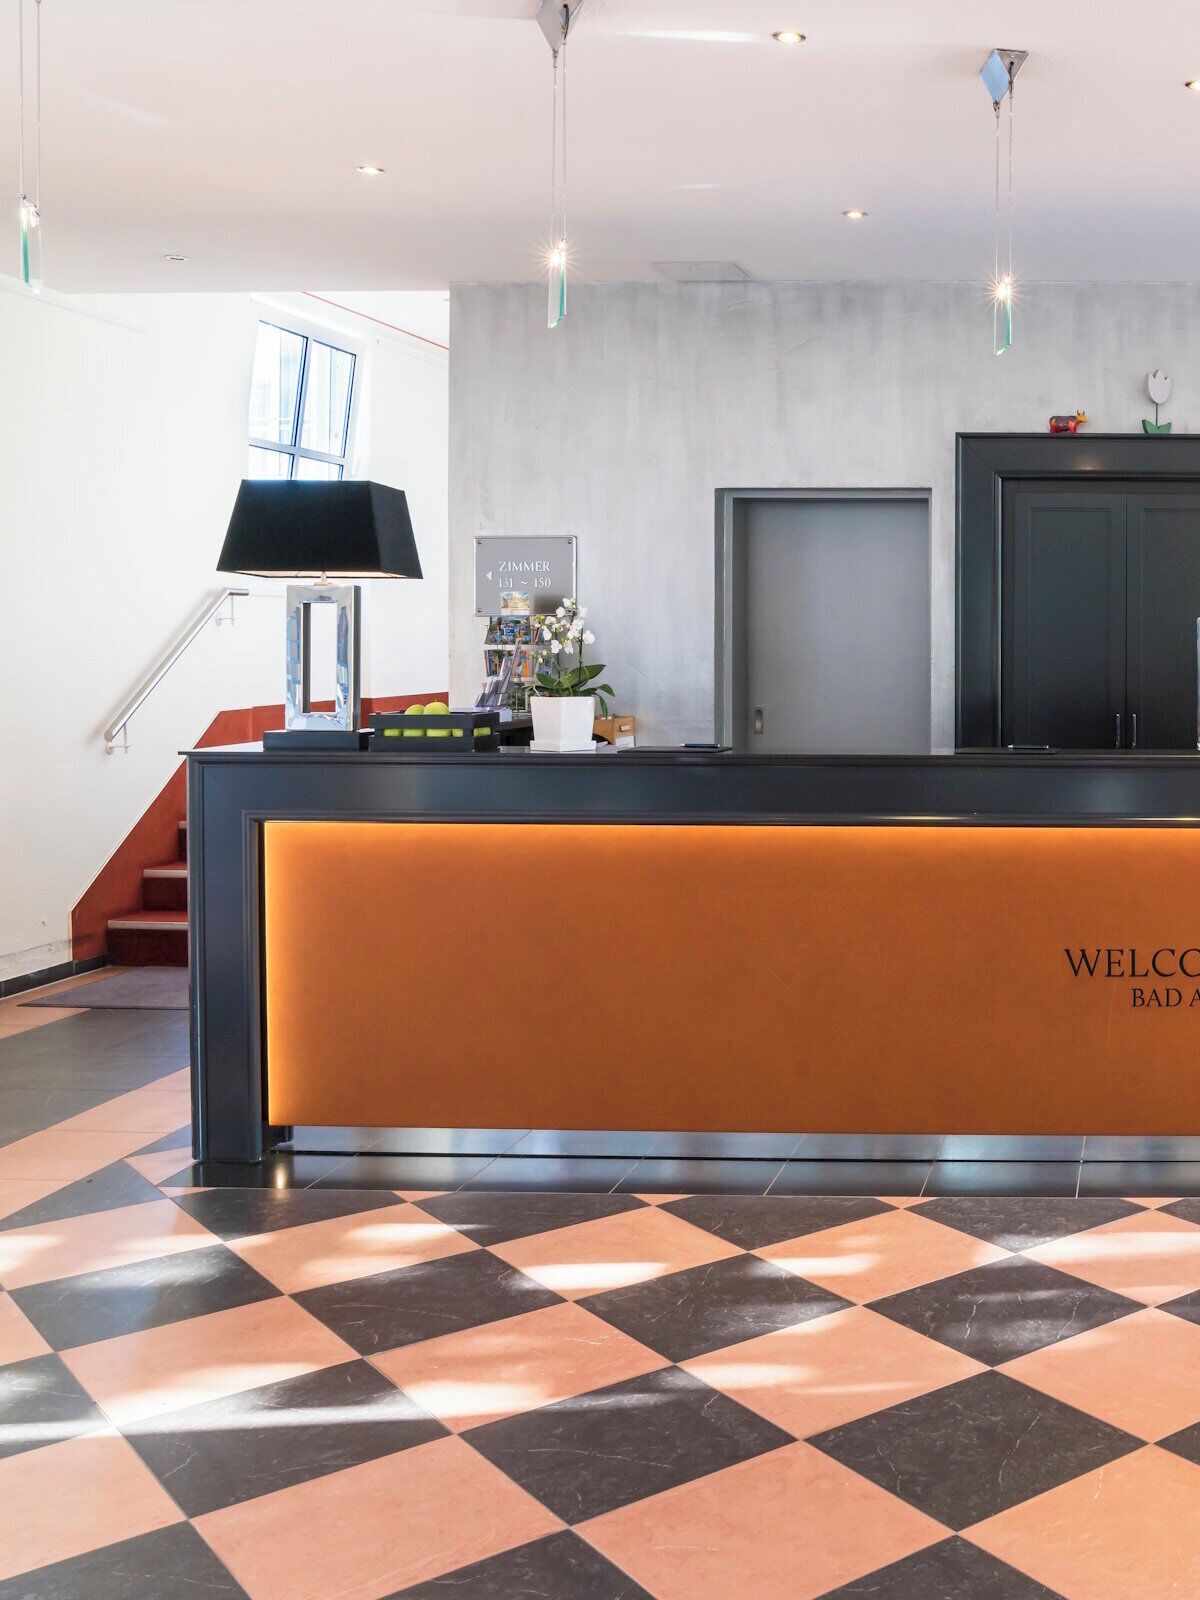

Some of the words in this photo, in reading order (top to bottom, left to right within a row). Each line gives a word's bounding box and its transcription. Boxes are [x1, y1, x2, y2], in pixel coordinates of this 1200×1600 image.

[498, 560, 550, 572] ZIMMER
[498, 578, 513, 588] 131
[534, 578, 552, 588] 150
[1131, 988, 1183, 1008] BAD
